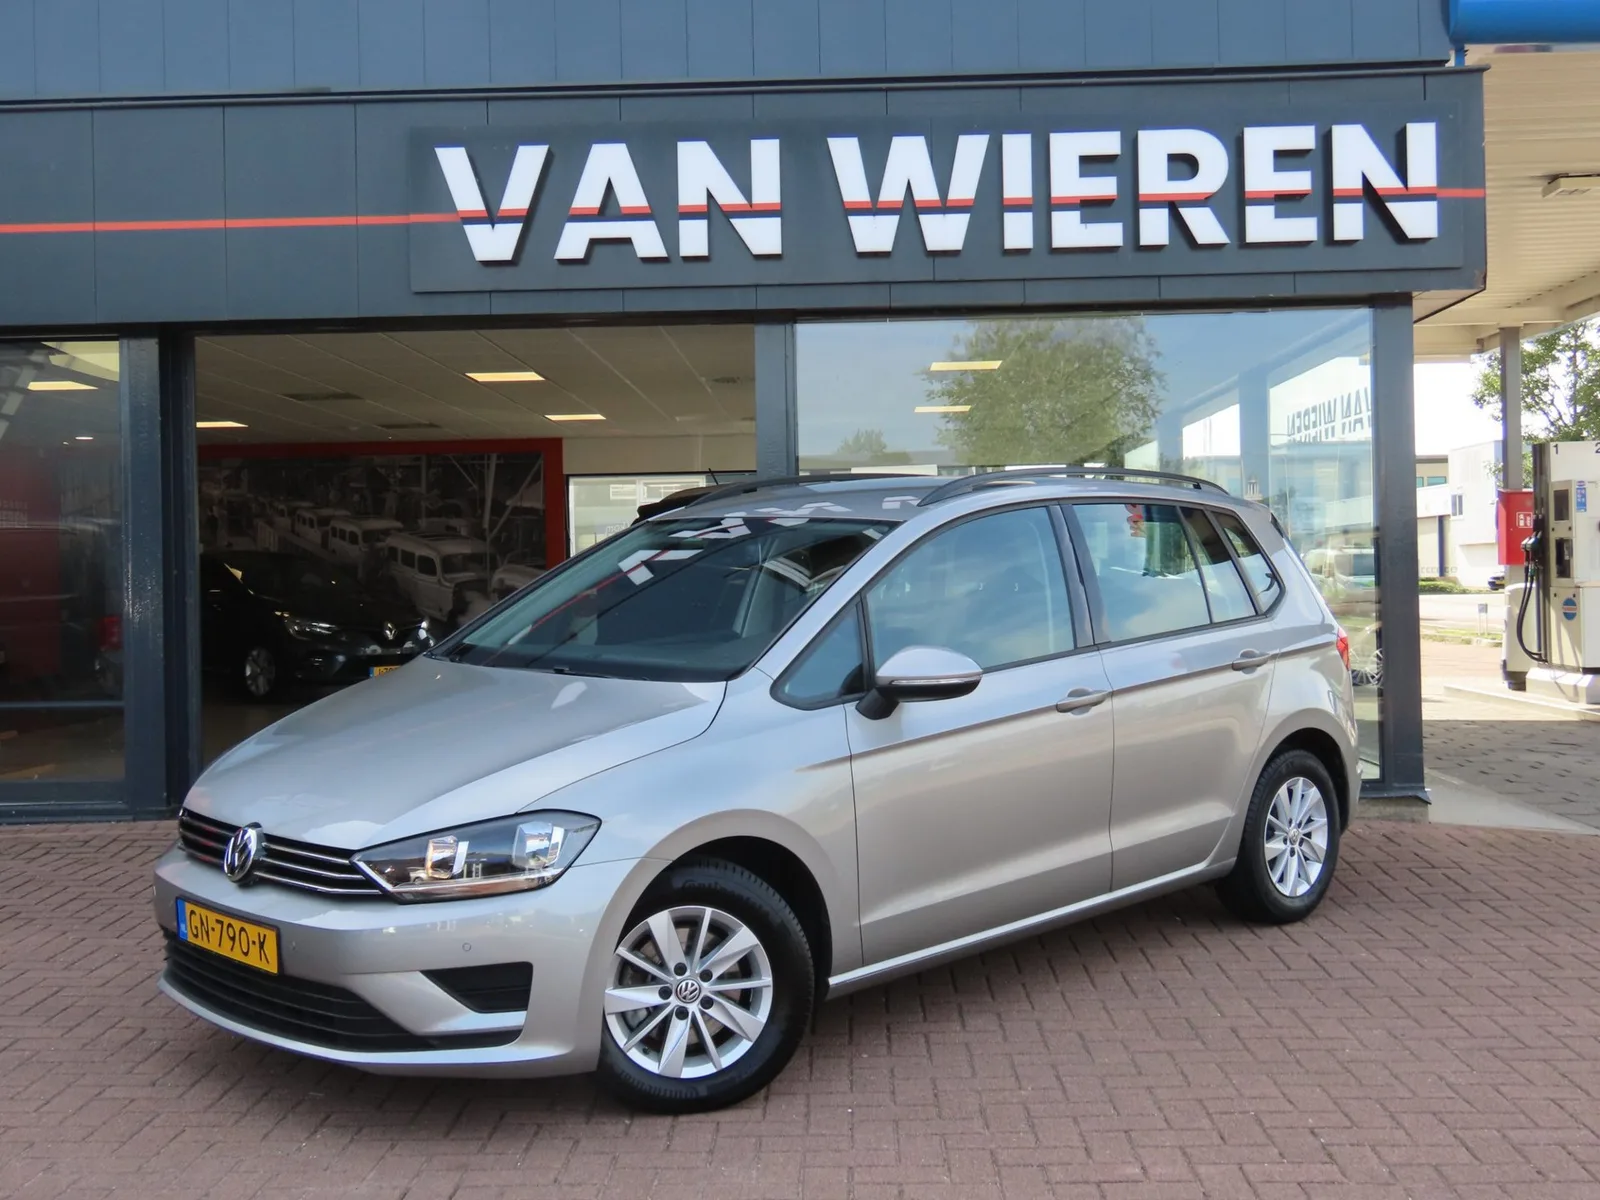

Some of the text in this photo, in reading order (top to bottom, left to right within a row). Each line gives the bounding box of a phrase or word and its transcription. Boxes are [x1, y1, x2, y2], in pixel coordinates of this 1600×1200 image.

[433, 121, 1438, 263] VAN WIEREN
[189, 909, 270, 965] GN-790-K
